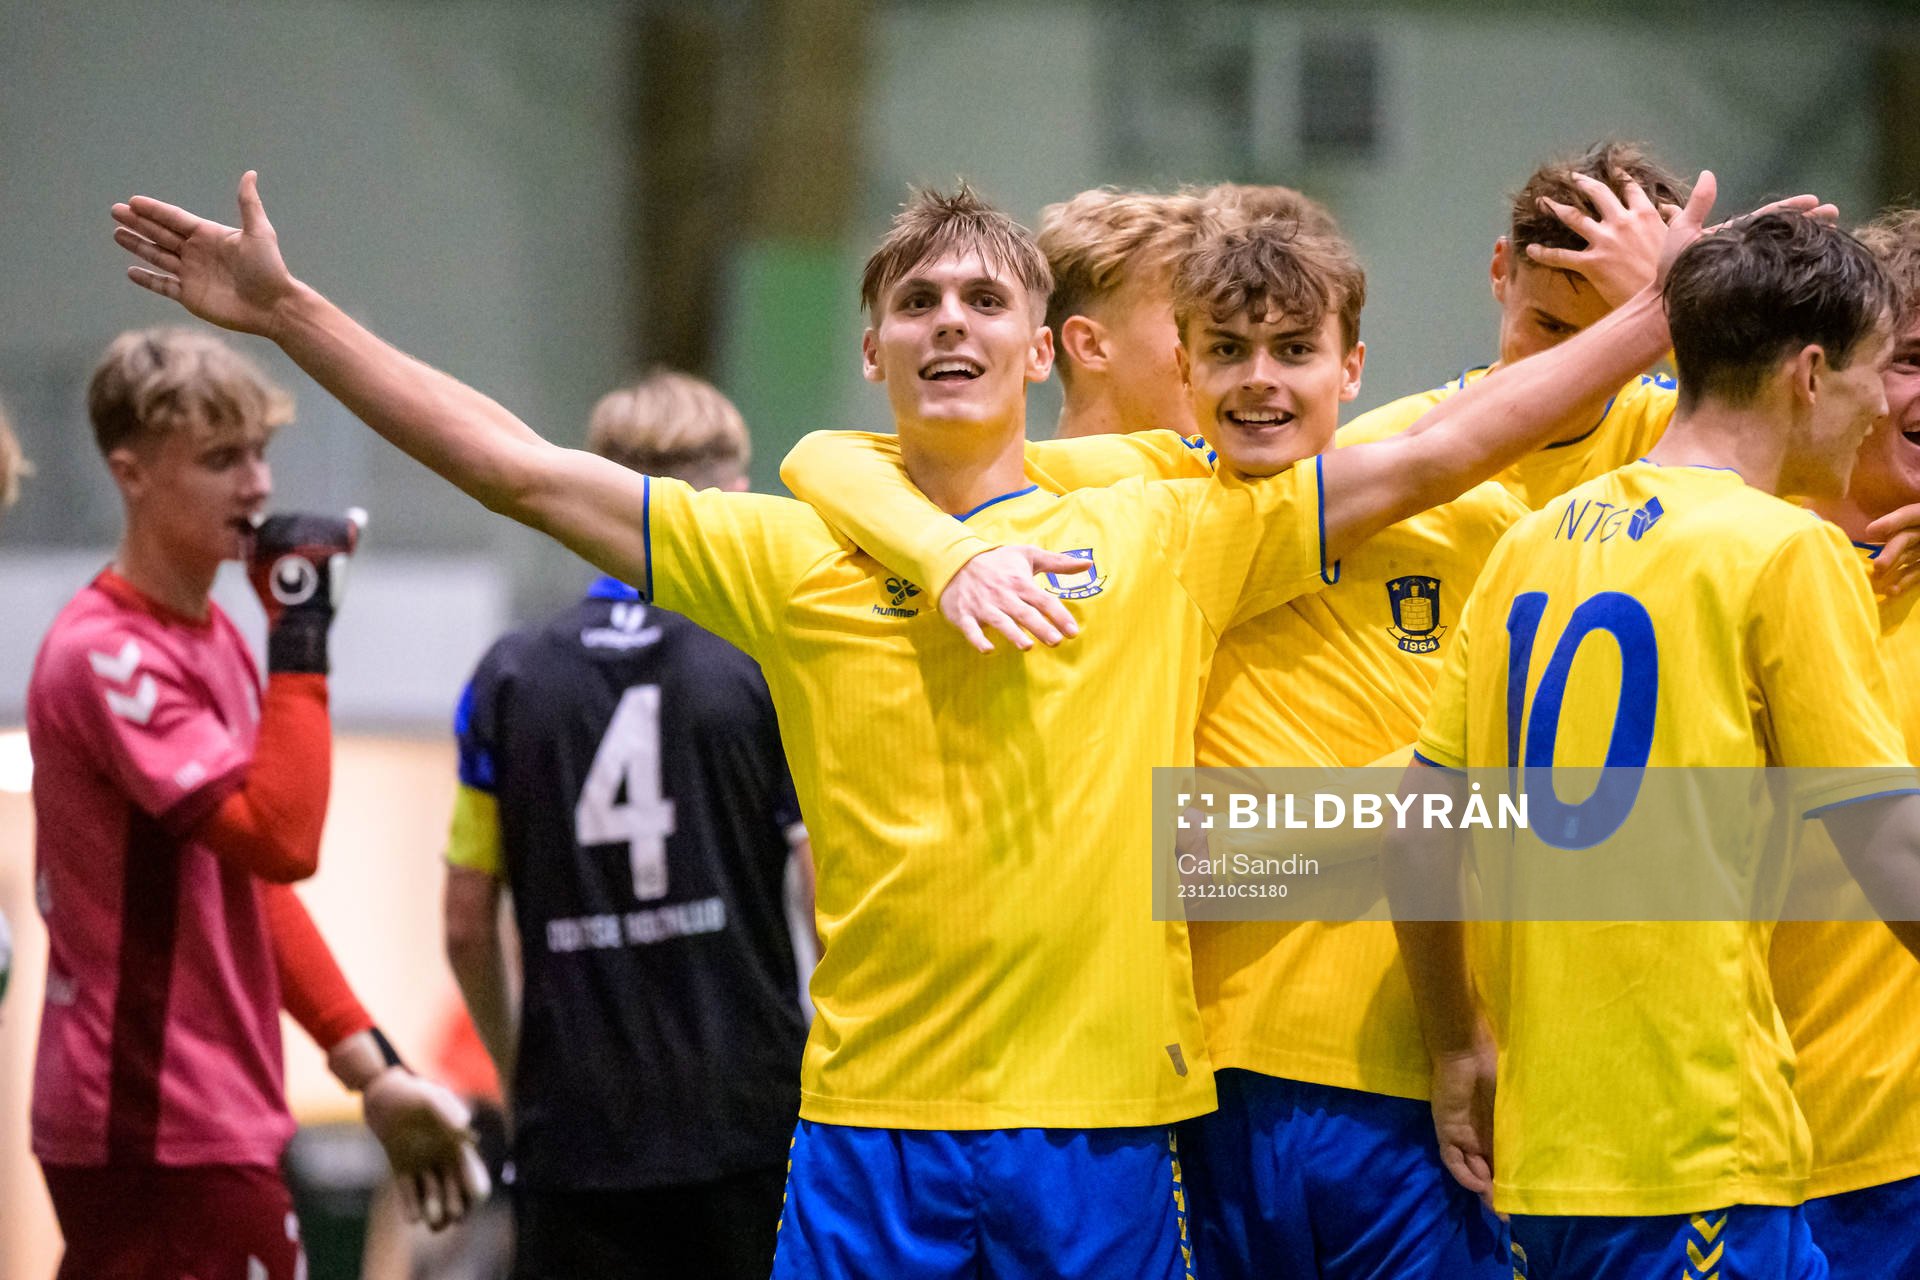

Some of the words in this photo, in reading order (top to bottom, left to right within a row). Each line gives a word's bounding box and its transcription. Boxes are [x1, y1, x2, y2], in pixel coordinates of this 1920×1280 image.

[872, 604, 919, 618] hummel
[1402, 639, 1437, 652] 1964
[1506, 591, 1658, 850] 10
[575, 684, 677, 900] 4
